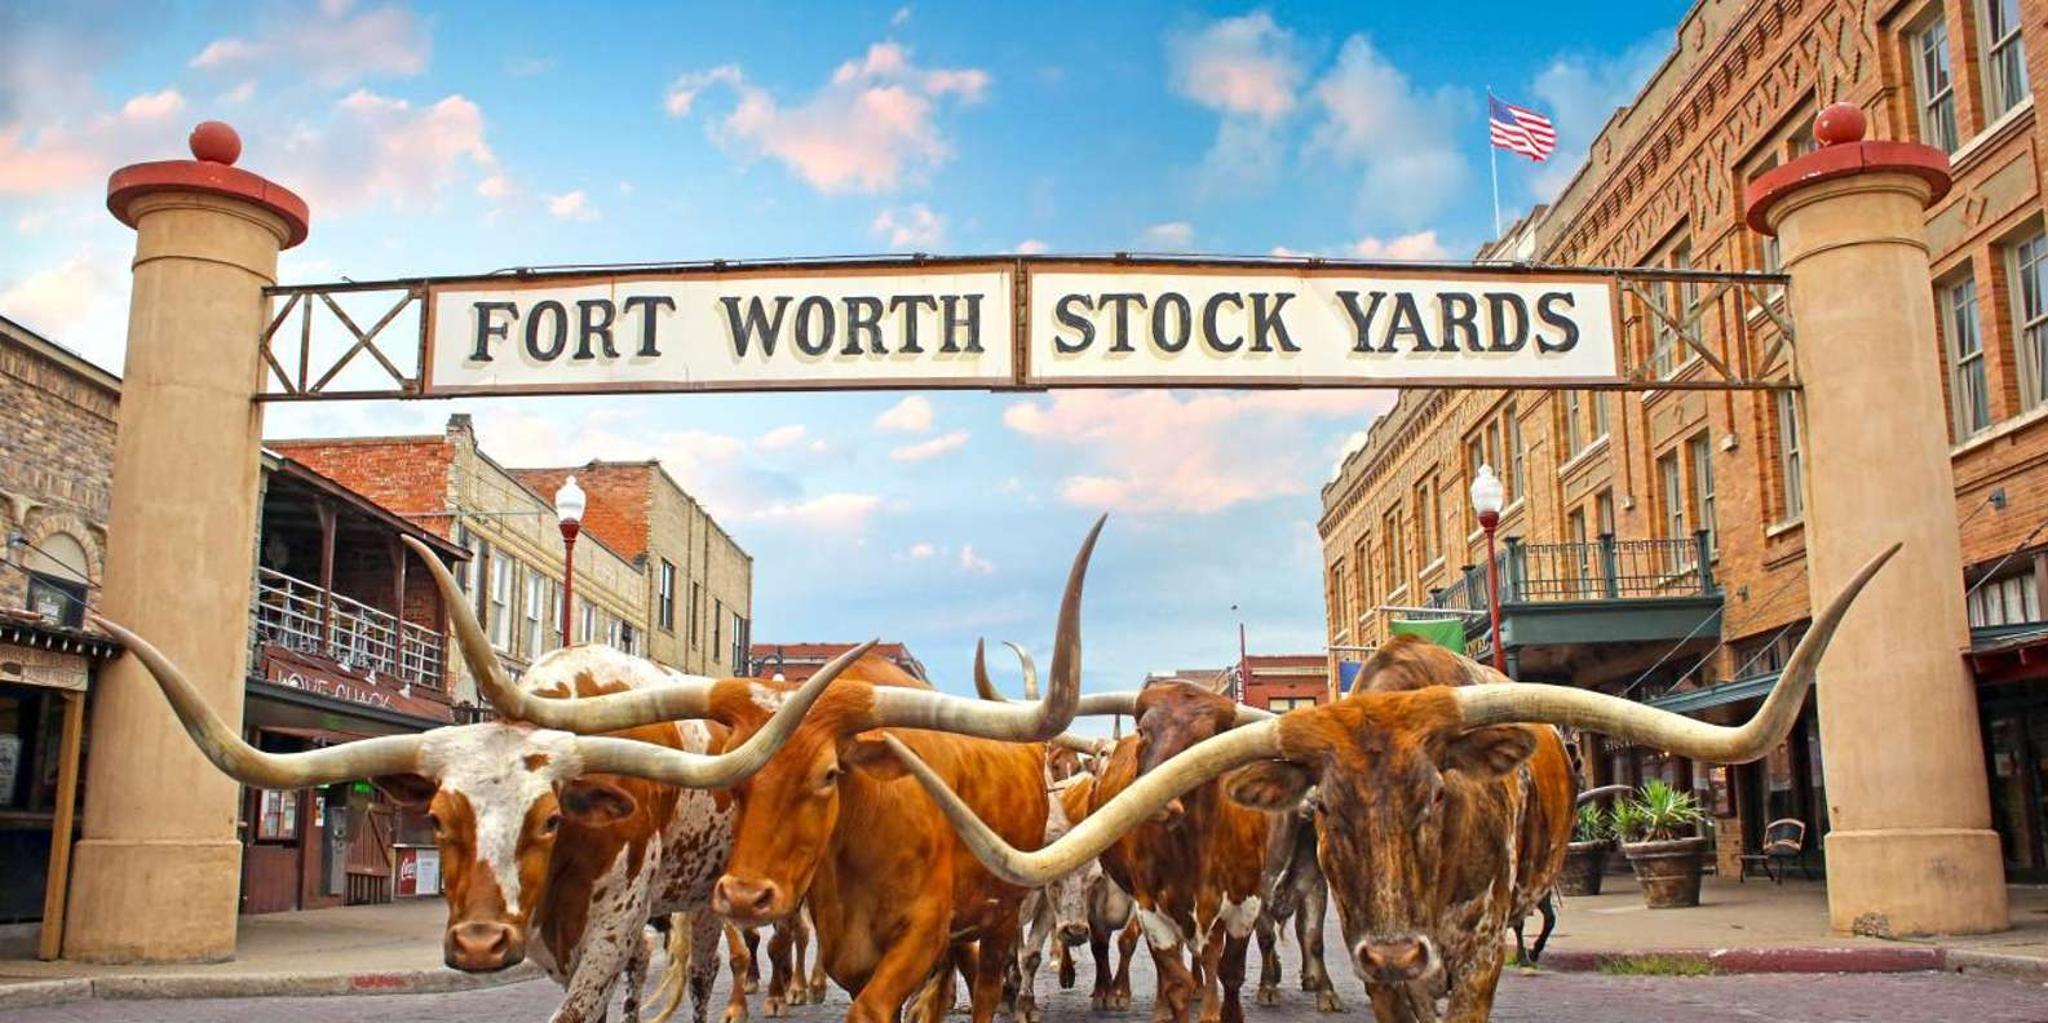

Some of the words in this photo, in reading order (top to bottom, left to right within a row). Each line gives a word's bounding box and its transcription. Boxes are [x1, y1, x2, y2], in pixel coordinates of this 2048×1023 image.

[468, 295, 677, 362] FORT
[719, 293, 985, 357] WORTH
[1054, 291, 1301, 353] STOCK
[1335, 290, 1581, 354] YARDS
